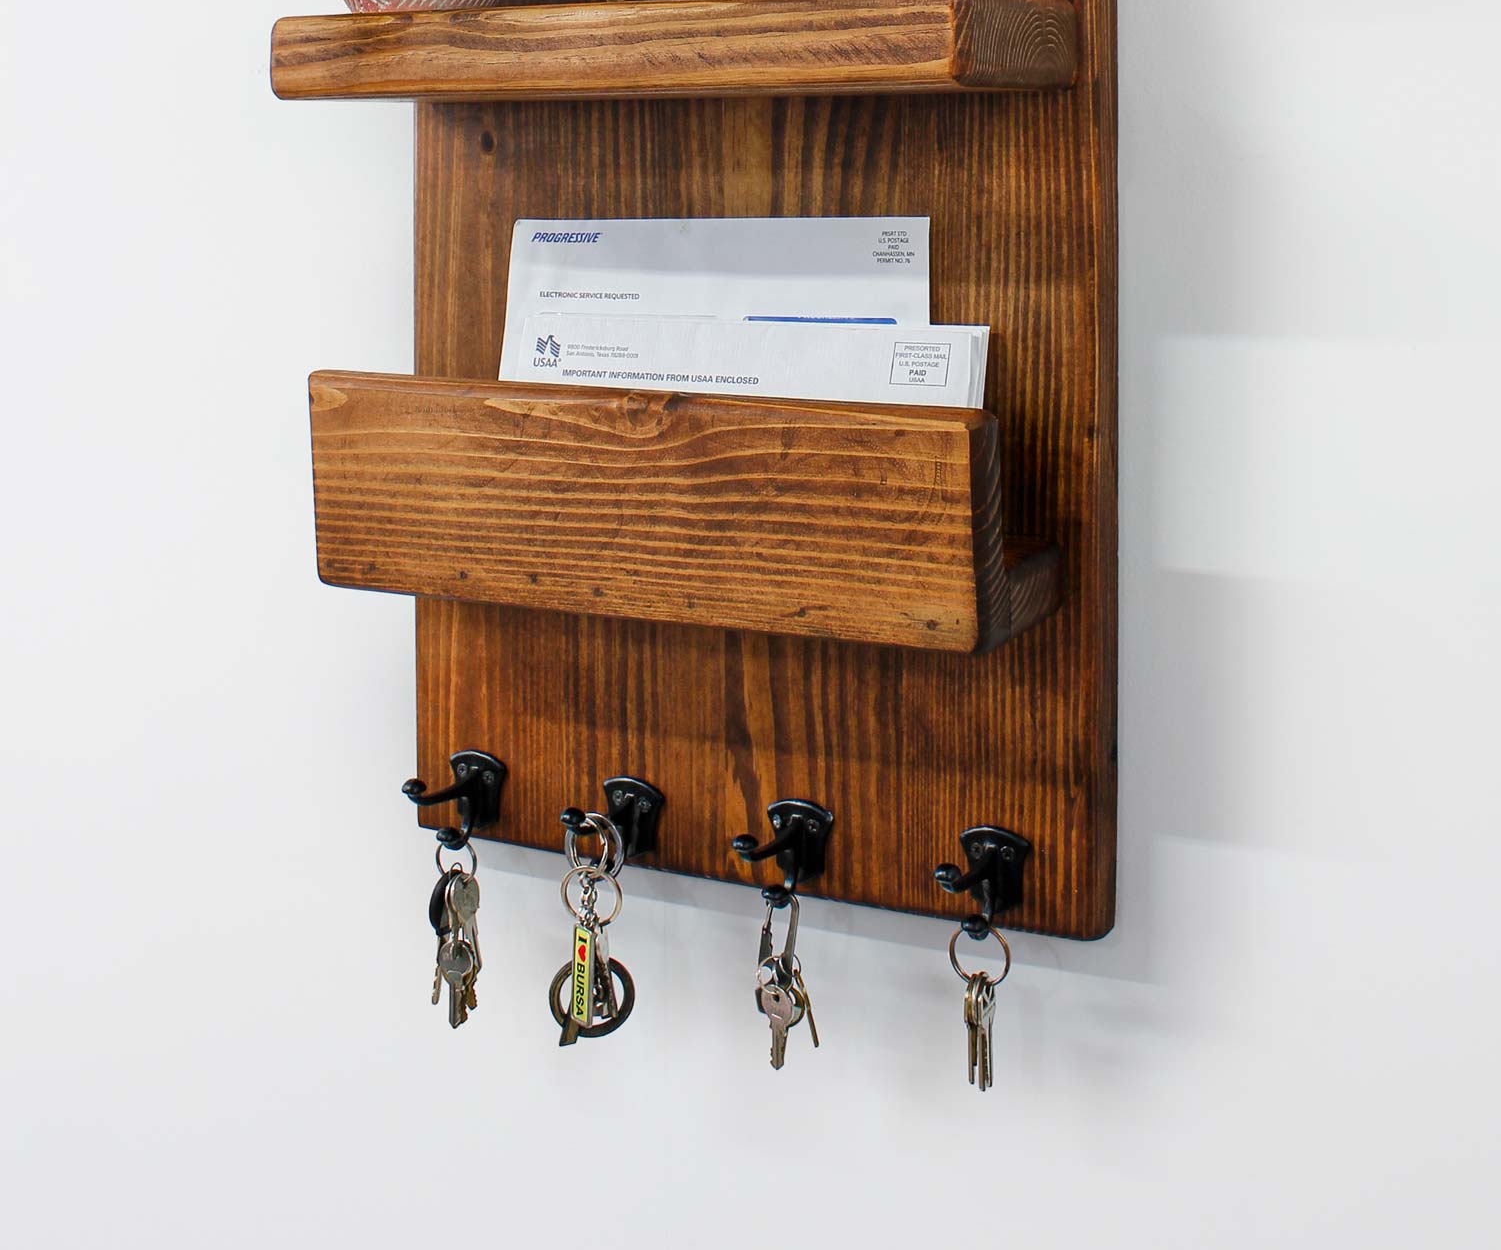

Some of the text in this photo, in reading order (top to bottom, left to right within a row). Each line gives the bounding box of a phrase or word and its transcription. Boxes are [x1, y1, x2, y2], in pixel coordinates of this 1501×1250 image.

[531, 232, 601, 243] PROGRESSIVE
[540, 291, 640, 301] ELECTRONIC SERVICE REQUESTED
[562, 369, 759, 386] IMPORTANT INFORMATION FROM USAA ENCLOSED
[576, 935, 587, 1016] I BURSA
